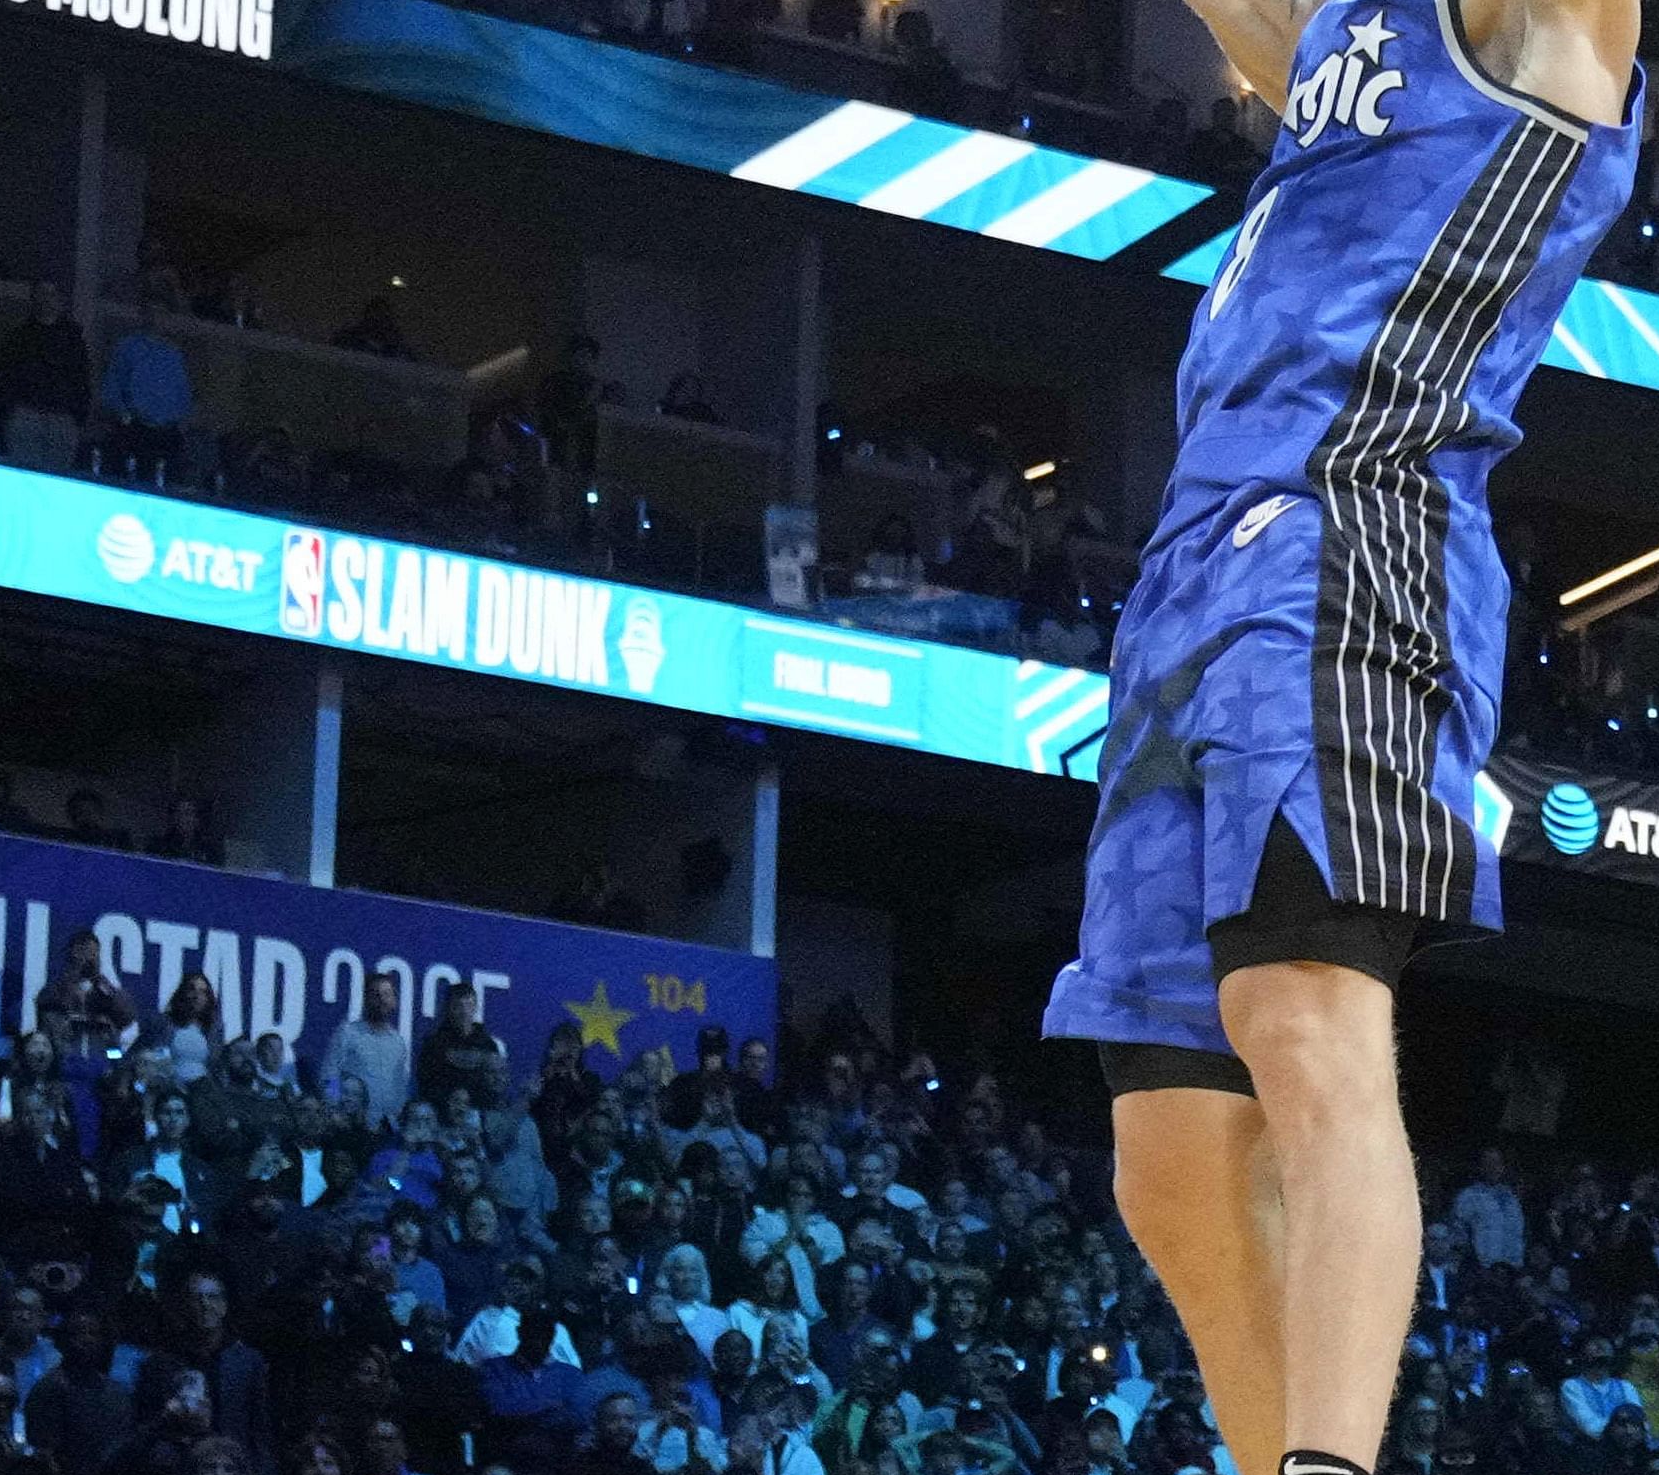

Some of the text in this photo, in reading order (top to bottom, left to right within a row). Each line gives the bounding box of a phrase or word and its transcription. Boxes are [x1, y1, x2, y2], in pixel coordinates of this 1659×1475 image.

[160, 536, 264, 596] AT&T
[327, 536, 611, 688] SLAM DUNK
[642, 975, 708, 1019] 104
